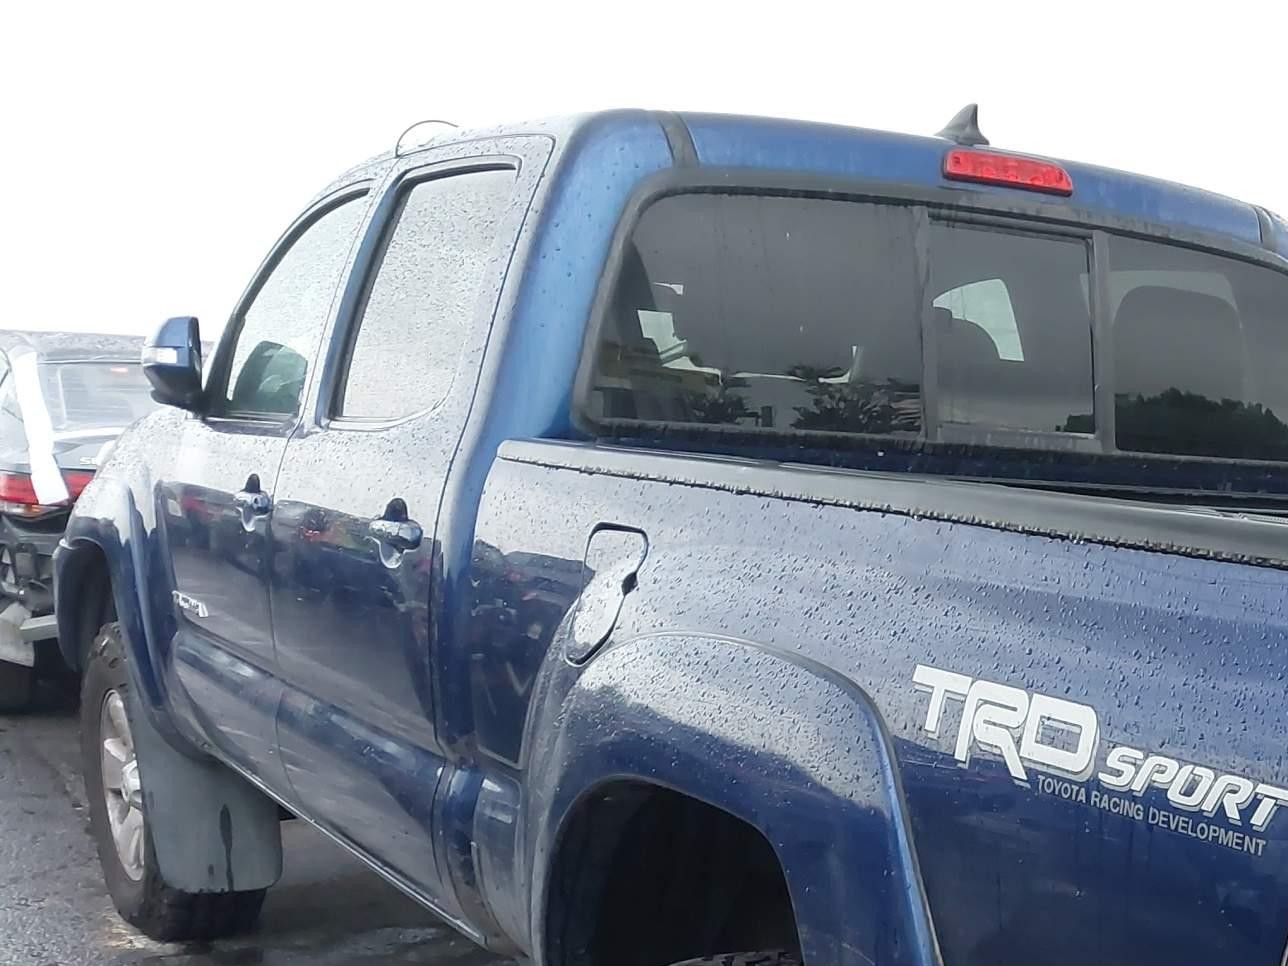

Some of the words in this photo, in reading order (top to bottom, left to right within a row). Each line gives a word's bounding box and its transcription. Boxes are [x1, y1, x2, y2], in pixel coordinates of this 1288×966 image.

[912, 663, 1099, 787] TRD
[1037, 774, 1087, 804] TOYOTA
[1090, 791, 1144, 820] RACING
[1148, 806, 1267, 857] DEVELOPMENT
